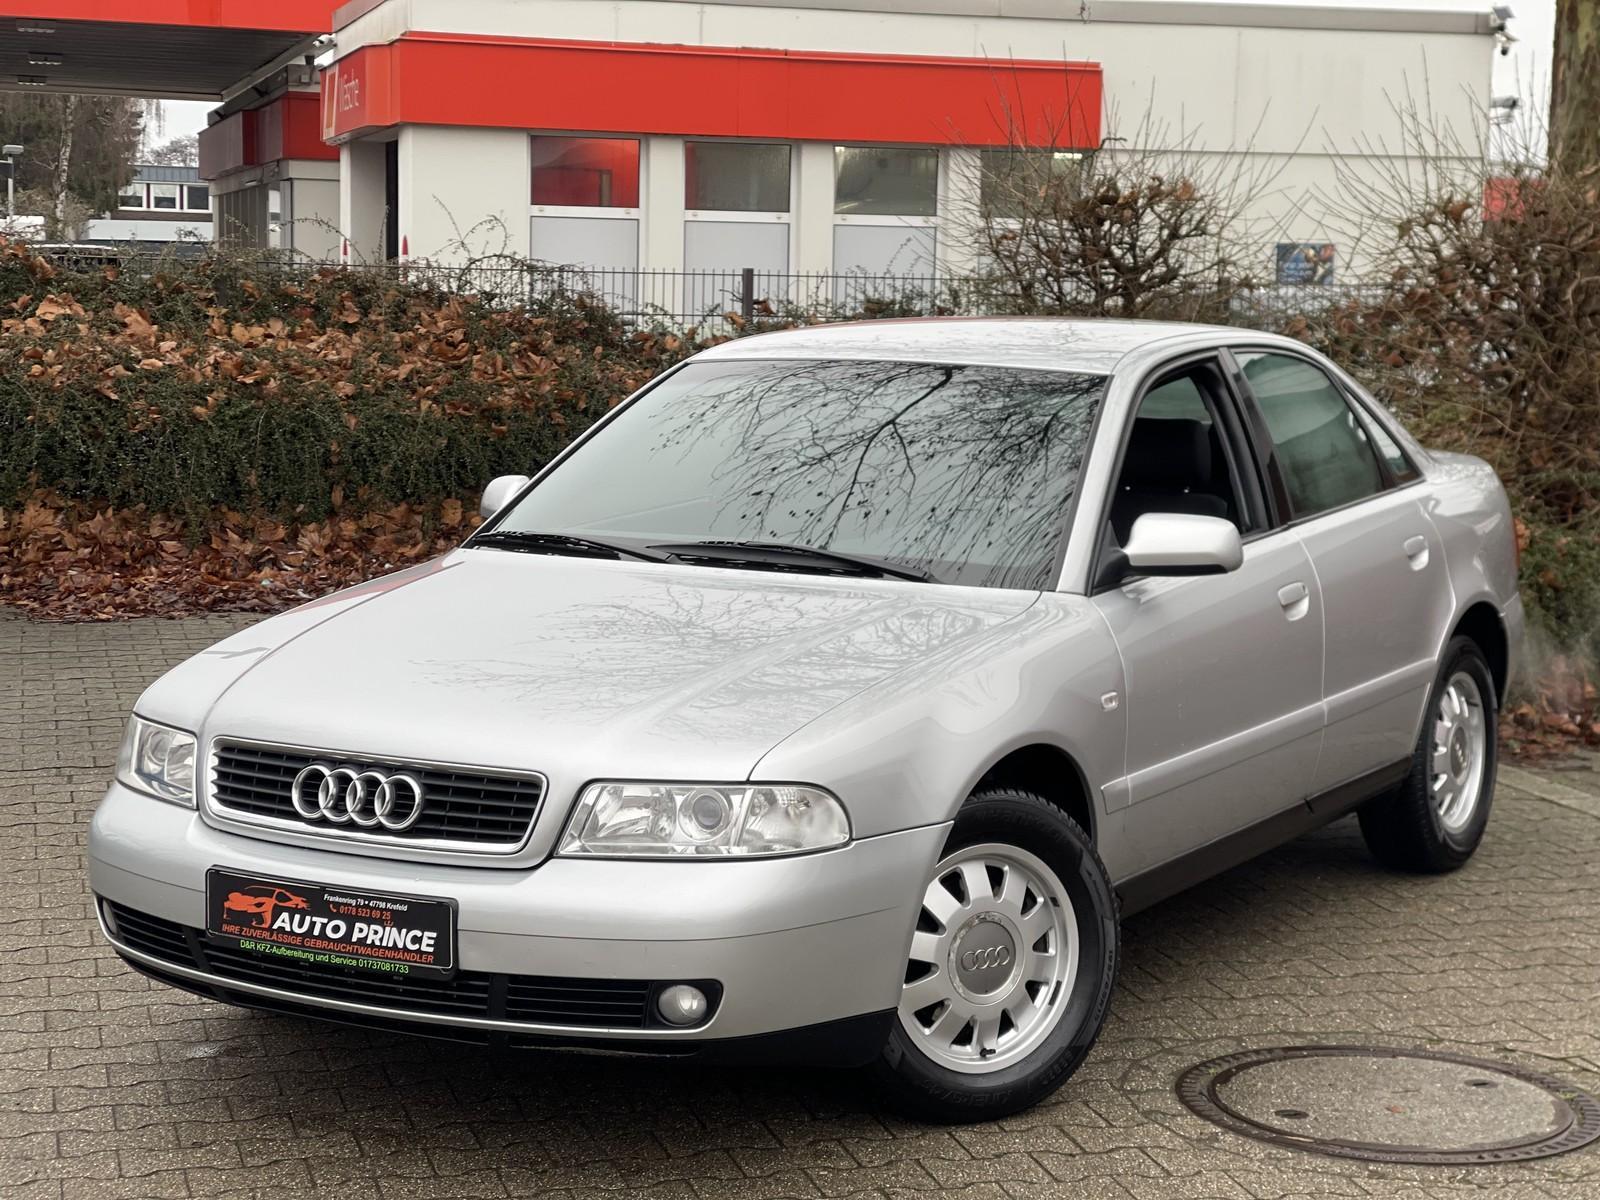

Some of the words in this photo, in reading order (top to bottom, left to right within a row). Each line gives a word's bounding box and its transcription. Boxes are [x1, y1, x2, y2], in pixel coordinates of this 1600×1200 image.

[323, 894, 357, 907] Frankenring
[357, 898, 364, 906] 79
[369, 900, 386, 909] 47798
[386, 902, 408, 911] Krefeld
[339, 905, 356, 915] 0178
[357, 907, 370, 917] 523
[382, 911, 391, 920] 25
[222, 923, 241, 935] IHRE
[241, 927, 303, 946] ZUVERLÄSSIGE
[303, 937, 434, 964] GEBRAUCHTWAGENHÄNDLER
[272, 911, 347, 939] AUTO
[351, 922, 437, 953] PRINCE
[240, 939, 256, 950] D&R
[256, 941, 315, 962] KFZ-Aufbereitung
[315, 954, 329, 963] und
[330, 954, 358, 967] Service
[358, 958, 409, 974] 01737081733
